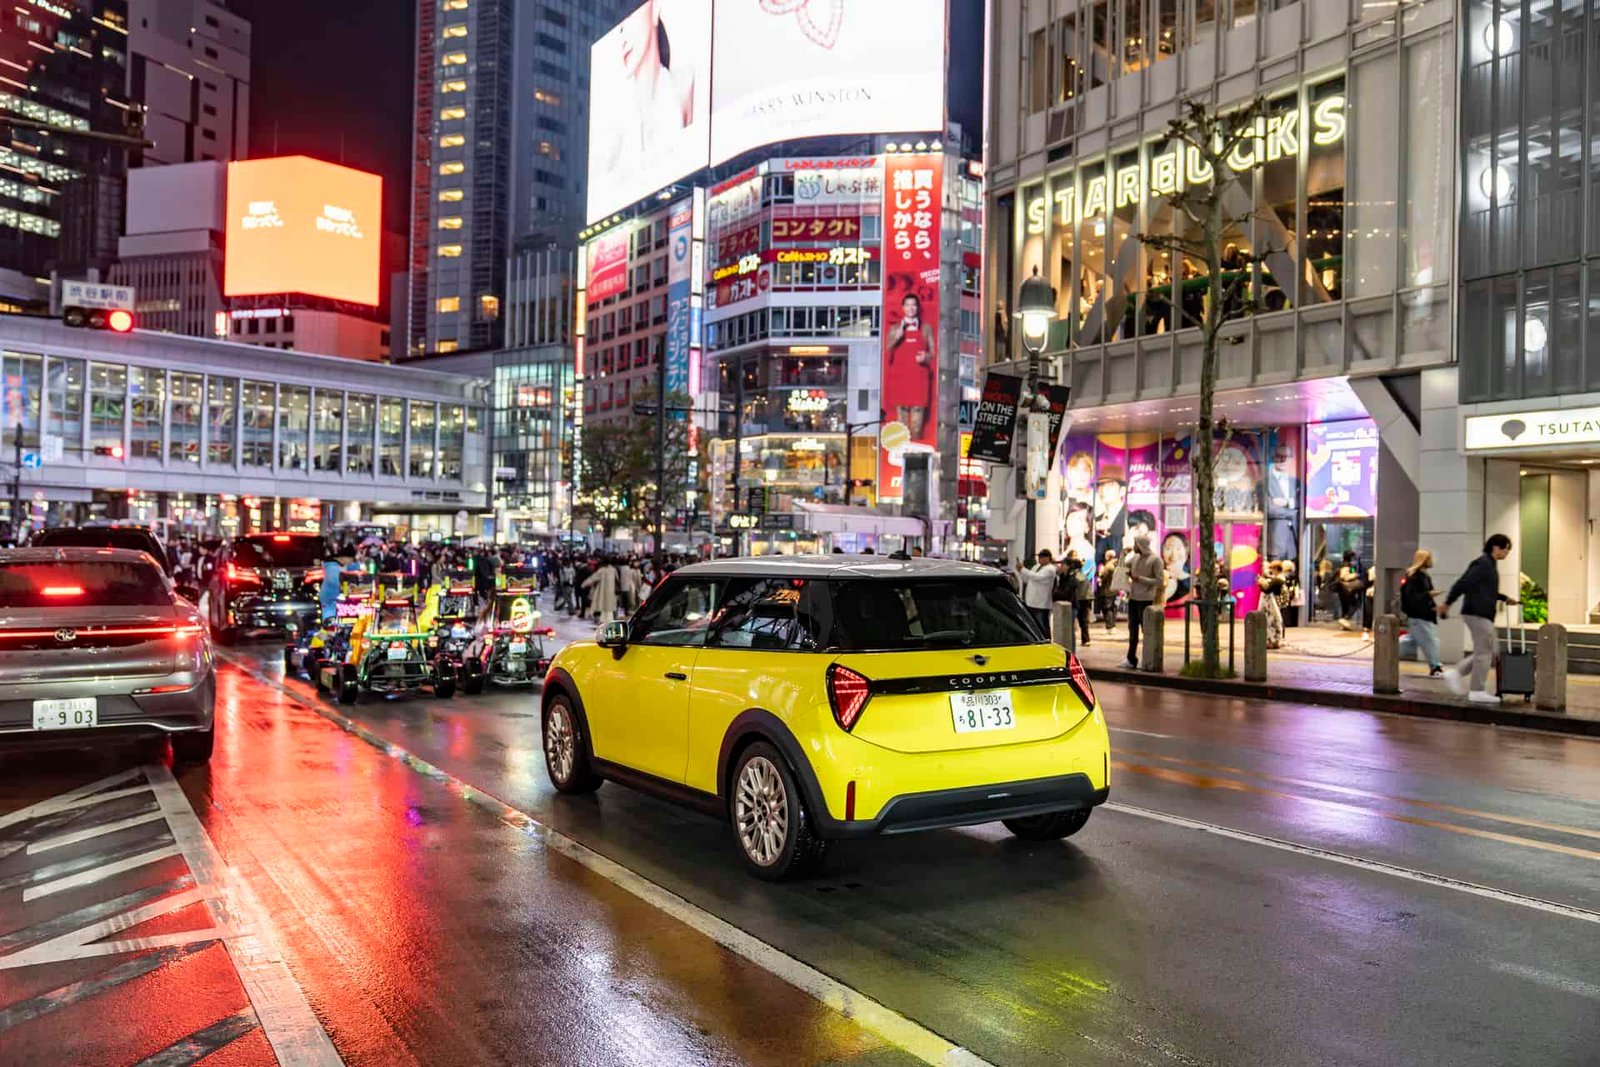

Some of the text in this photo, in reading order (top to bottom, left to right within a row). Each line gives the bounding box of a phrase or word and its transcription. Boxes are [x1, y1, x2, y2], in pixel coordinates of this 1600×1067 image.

[1027, 96, 1346, 234] STARBUCKS
[773, 219, 858, 237] コンタクト
[829, 246, 871, 265] ガスト
[981, 401, 996, 413] ON
[996, 403, 1015, 416] THE
[977, 412, 1010, 426] STREET
[949, 674, 1018, 686] COOPER
[967, 706, 1012, 729] 81-33
